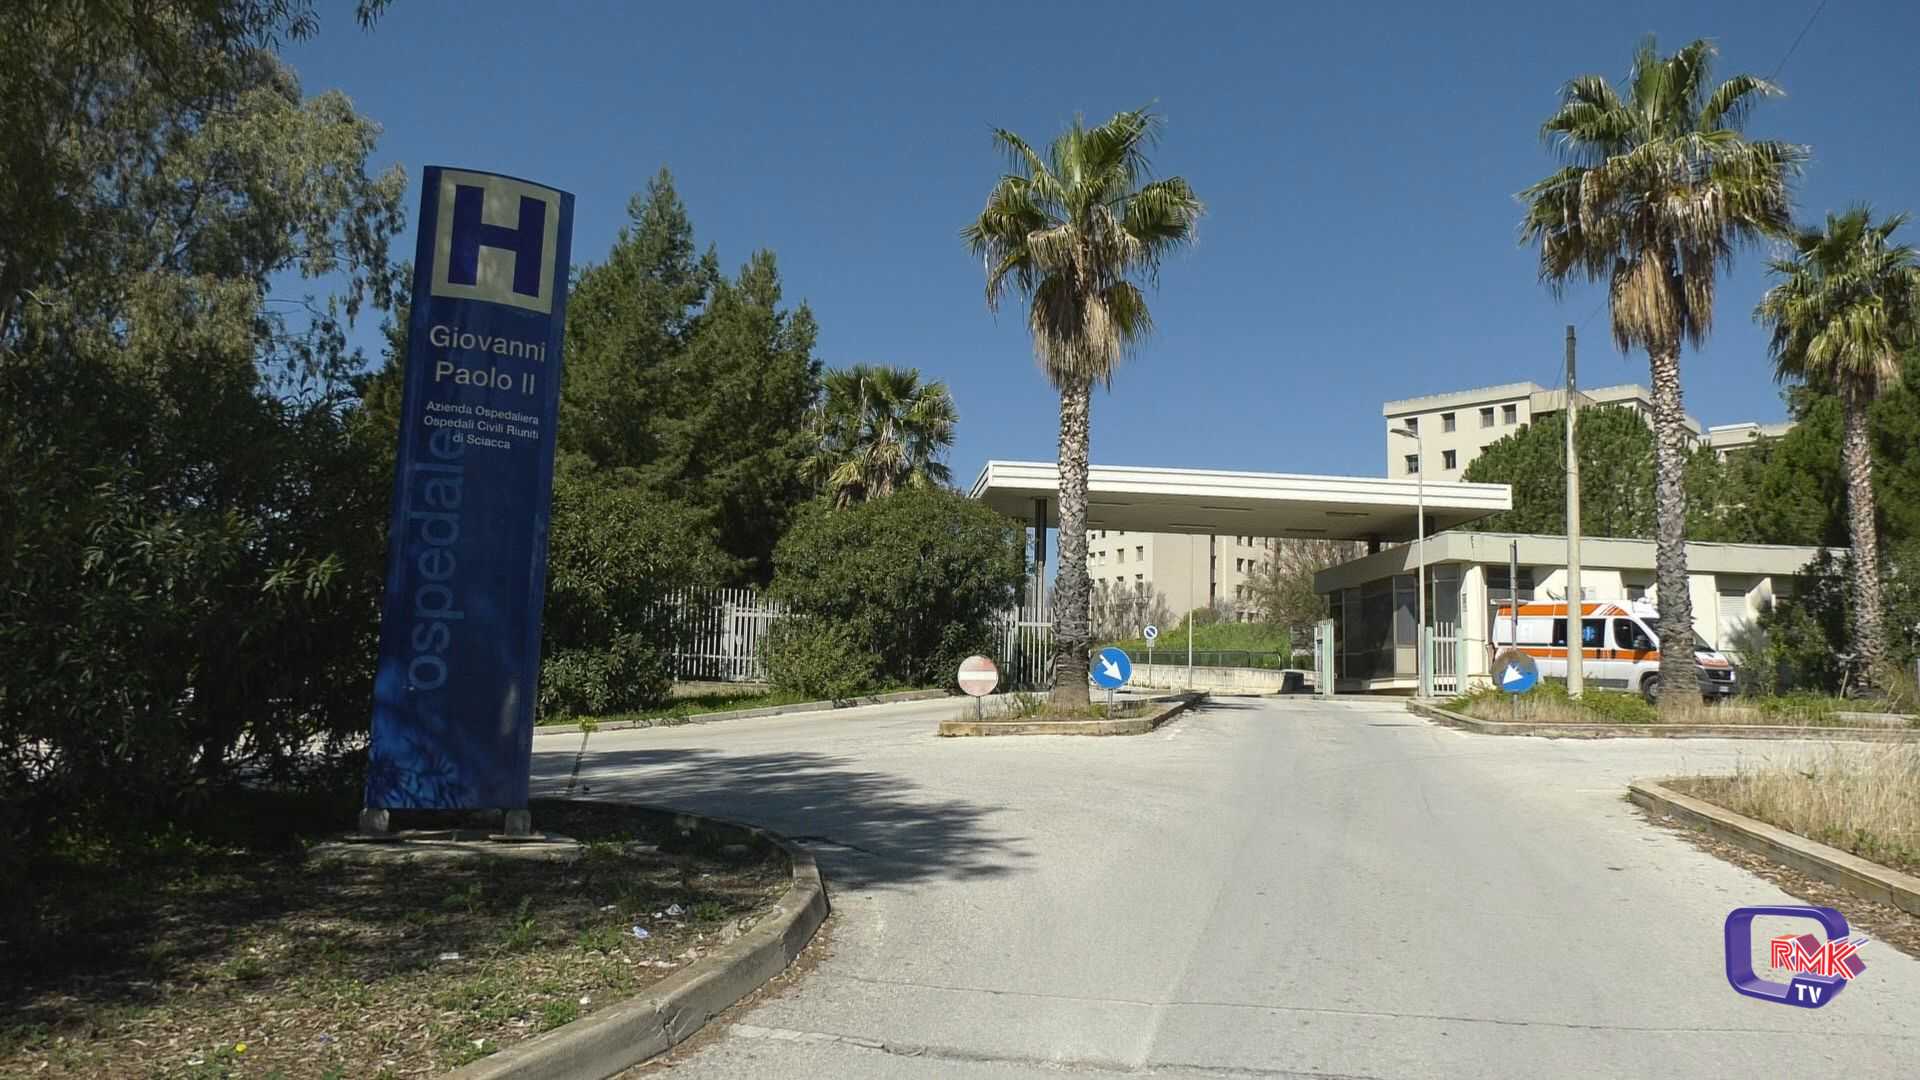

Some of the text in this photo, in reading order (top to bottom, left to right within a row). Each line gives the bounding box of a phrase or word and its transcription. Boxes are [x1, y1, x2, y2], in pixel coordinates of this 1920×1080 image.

[447, 184, 548, 298] H
[430, 325, 546, 362] Giovanni
[435, 360, 535, 395] Paolo II
[424, 415, 539, 440] Ospedali Civili Riuniti
[426, 401, 539, 425] Azienda Ospedaliera
[452, 431, 511, 449] di Sciacca
[407, 428, 465, 691] ospedale
